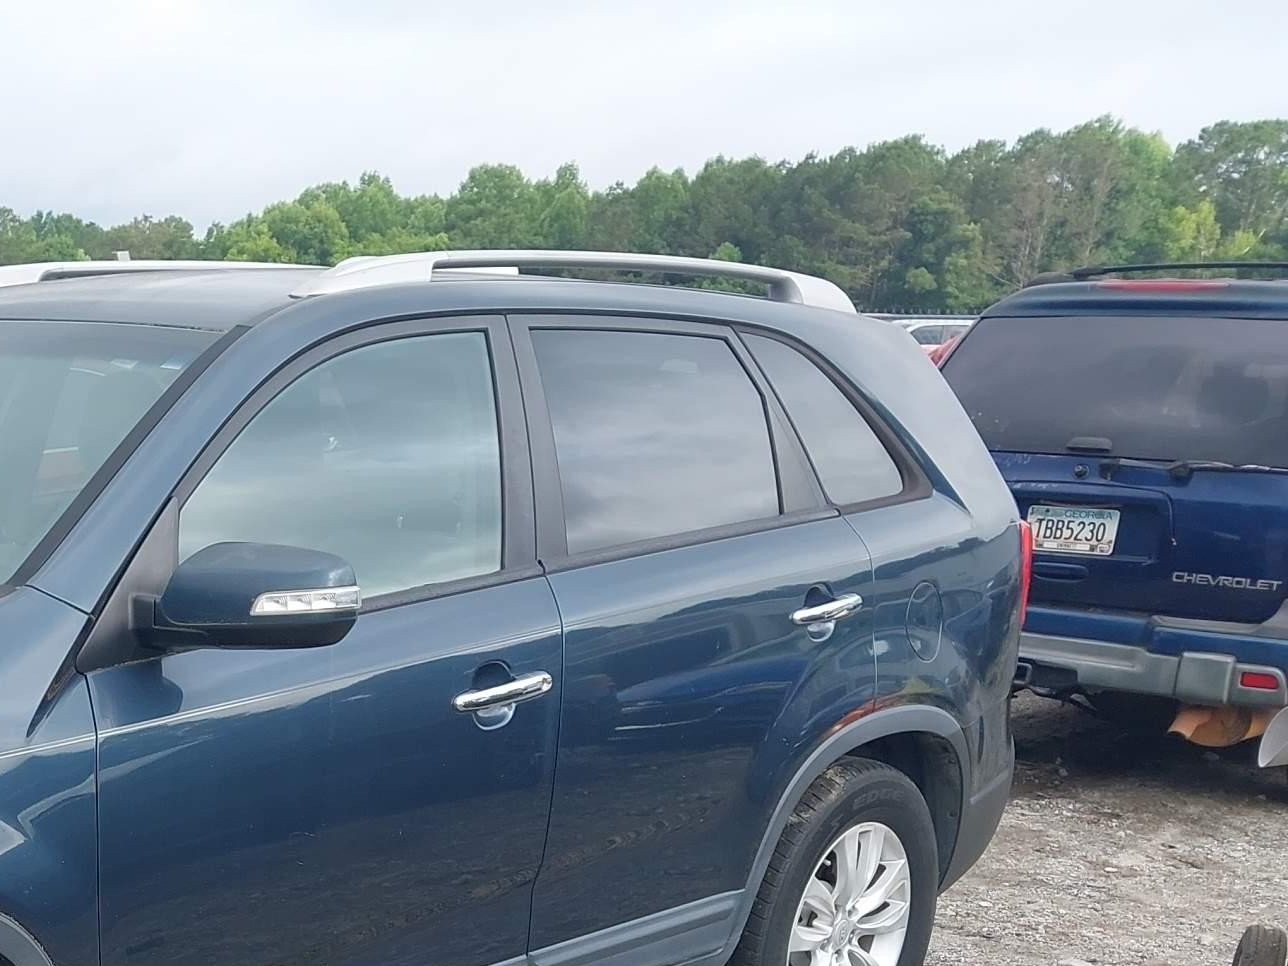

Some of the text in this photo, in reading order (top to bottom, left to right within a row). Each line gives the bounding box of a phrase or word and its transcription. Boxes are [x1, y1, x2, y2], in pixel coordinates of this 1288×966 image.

[1064, 509, 1113, 520] GEORA
[1035, 518, 1107, 543] TBB5230
[1172, 571, 1283, 591] CHEVROLET
